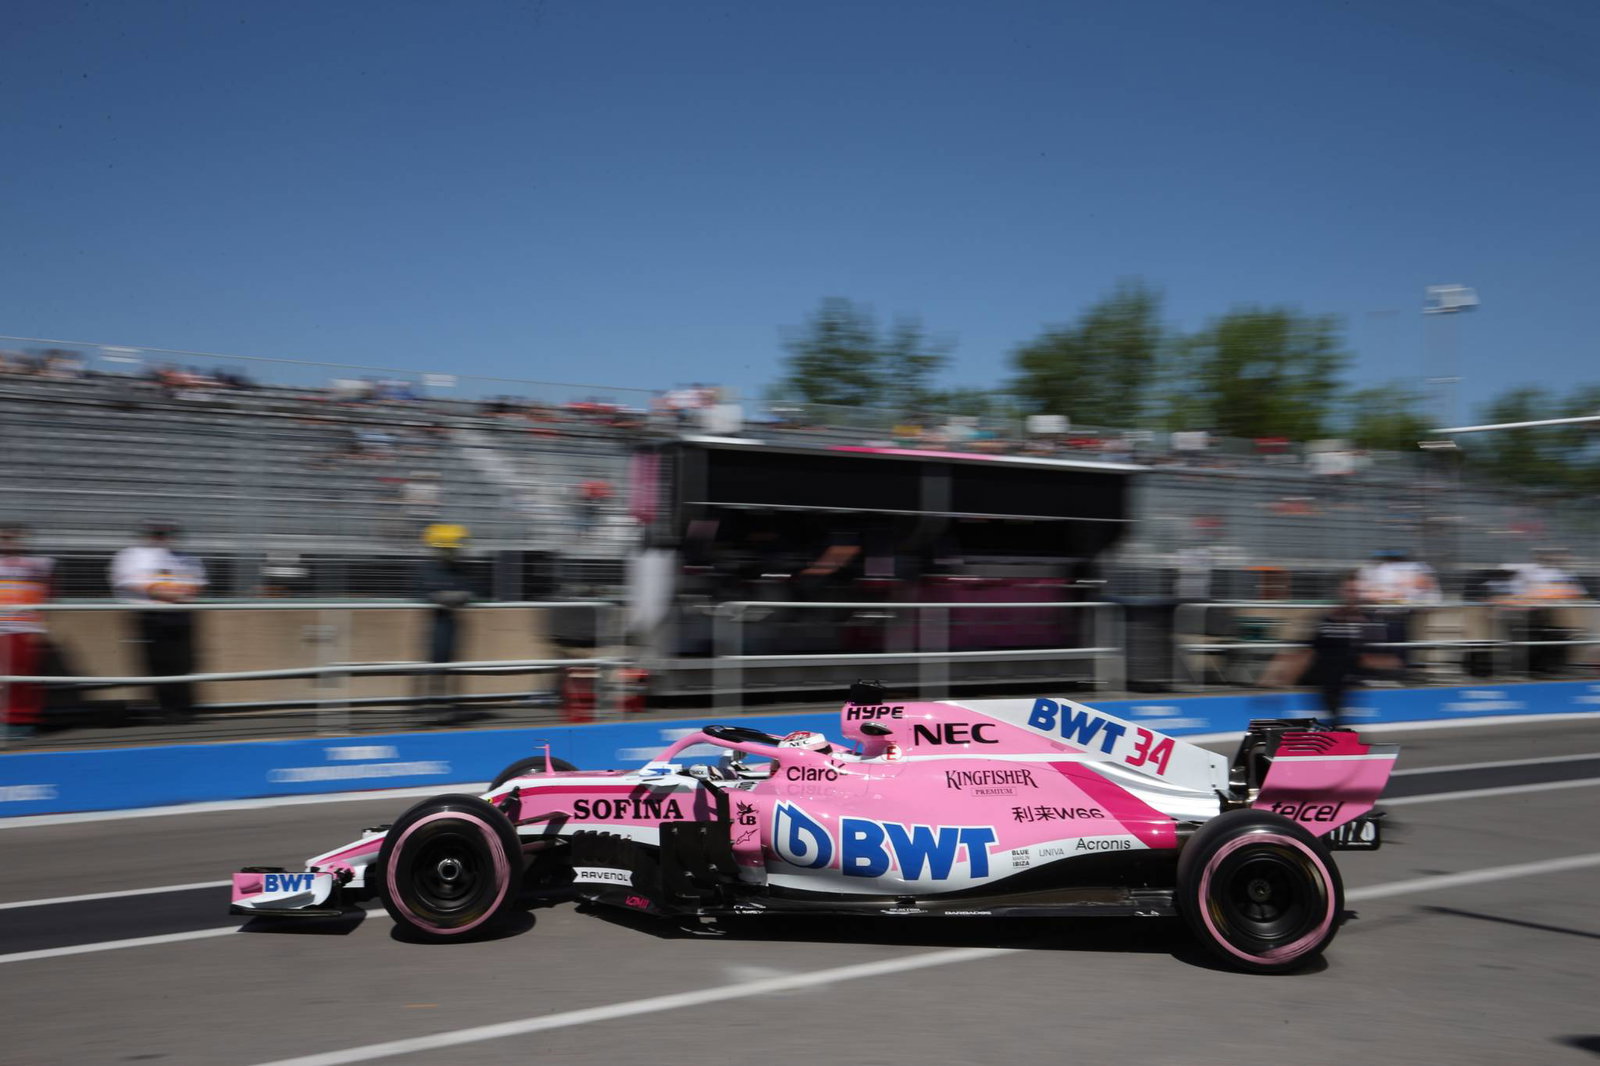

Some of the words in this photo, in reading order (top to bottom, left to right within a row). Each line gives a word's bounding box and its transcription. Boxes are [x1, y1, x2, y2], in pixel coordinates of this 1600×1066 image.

[847, 706, 904, 721] HYPE
[914, 723, 999, 746] NEC
[1028, 697, 1126, 754] BWT
[1125, 728, 1176, 776] 34
[786, 763, 844, 782] Claro
[945, 769, 1039, 790] KINGFISHER
[573, 799, 684, 820] SOFINA
[1011, 805, 1105, 823] 利来W66
[1271, 801, 1344, 822] telcel
[841, 819, 997, 881] BWT
[1039, 848, 1065, 857] UNIVA
[1075, 838, 1131, 850] Acronis
[264, 874, 315, 892] BWT
[581, 871, 629, 882] RAVENOL
